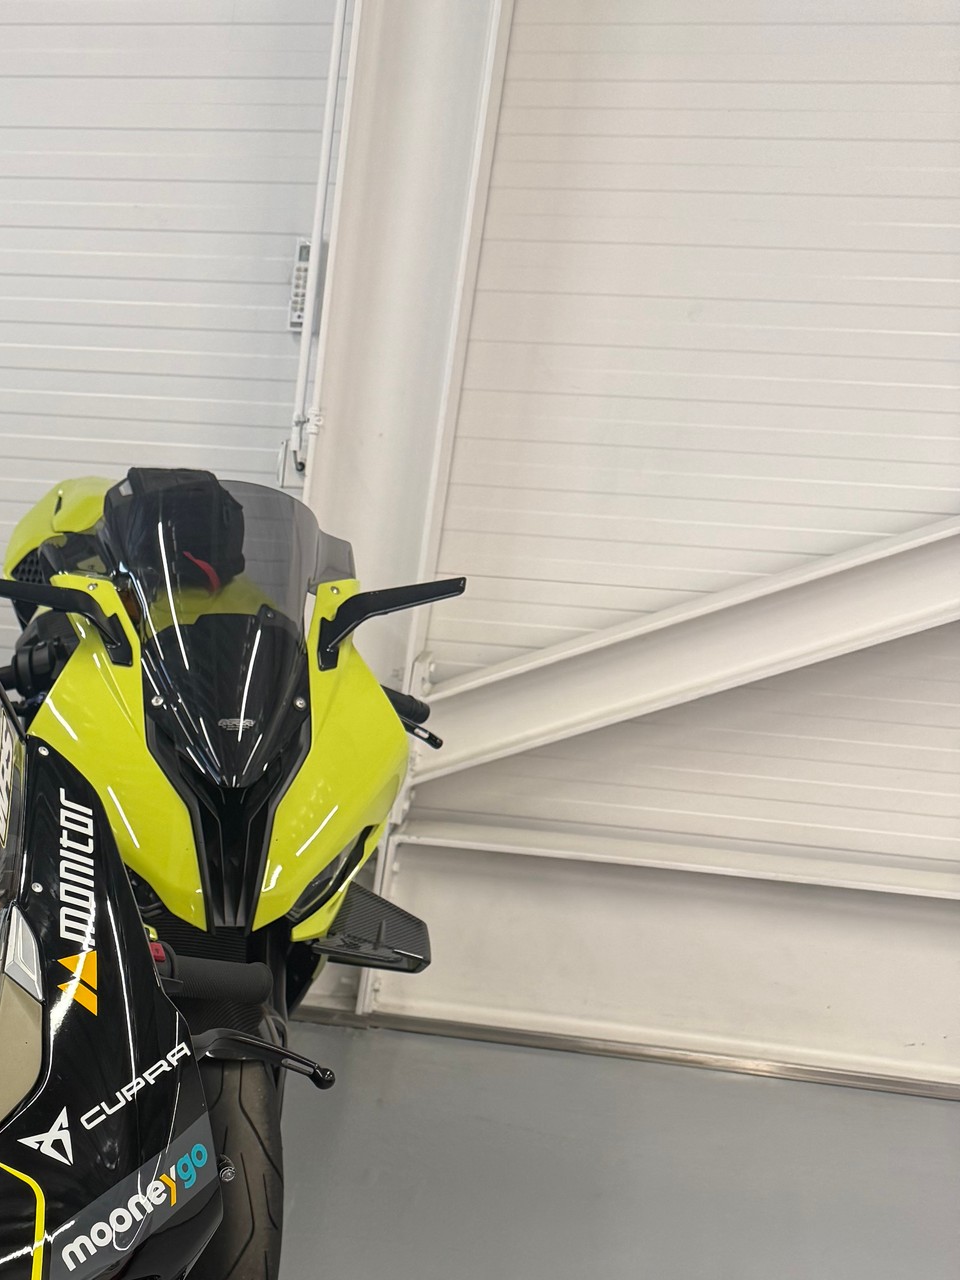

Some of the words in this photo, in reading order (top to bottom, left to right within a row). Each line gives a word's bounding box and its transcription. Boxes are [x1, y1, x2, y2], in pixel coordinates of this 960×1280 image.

[59, 788, 95, 947] monitor
[80, 1042, 191, 1130] CUPRA
[61, 1143, 208, 1272] mooneygo
